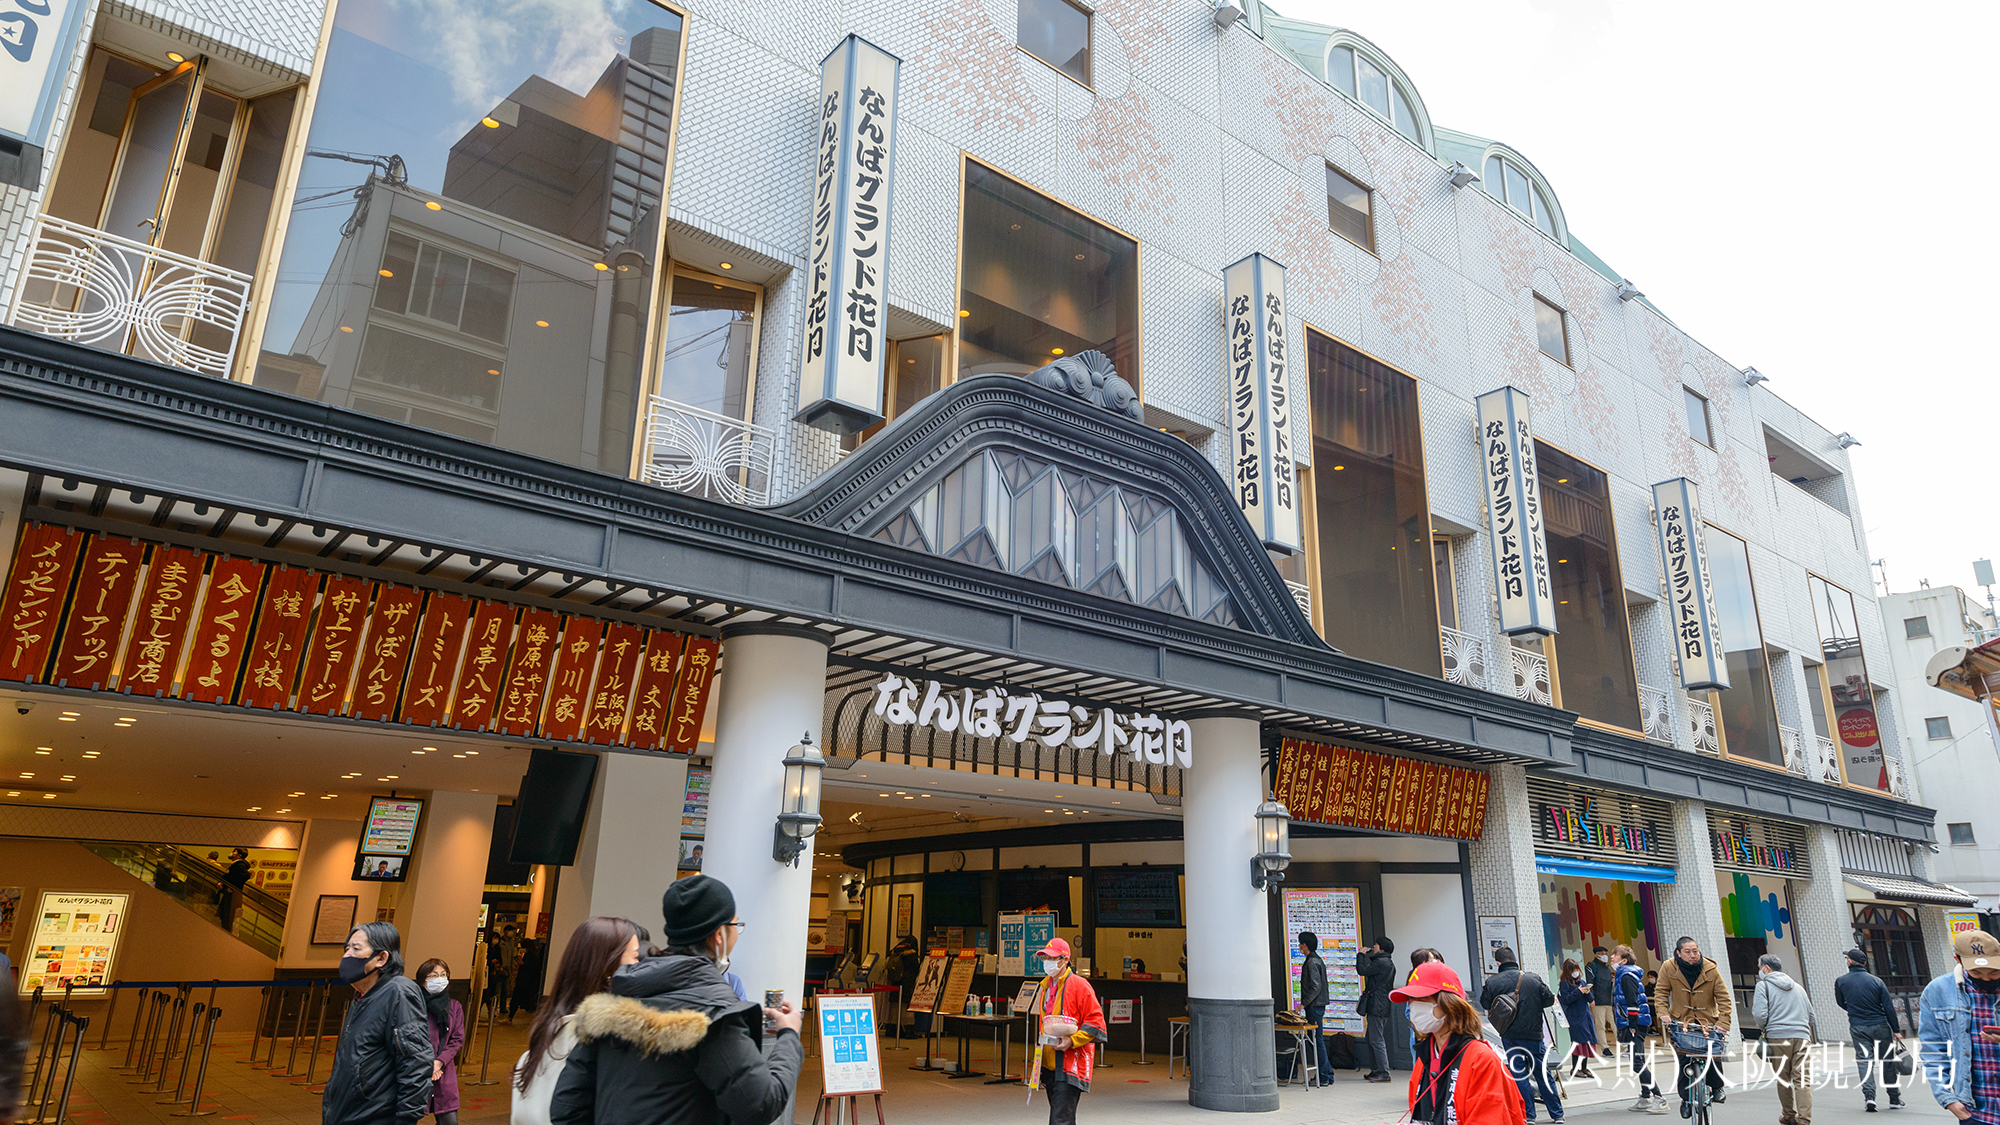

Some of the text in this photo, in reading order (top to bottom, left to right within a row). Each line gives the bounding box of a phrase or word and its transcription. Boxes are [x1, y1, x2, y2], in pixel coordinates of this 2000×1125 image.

[807, 89, 840, 364] なんばグランド花月
[846, 84, 887, 362] なんばグランド花月
[1231, 294, 1260, 511] なんばグランド花月
[1266, 291, 1292, 510] なんばグランド花月
[1486, 420, 1523, 600] なんばグランド花月
[1517, 418, 1548, 600] なんばグランド花月
[11, 540, 64, 670] メッセンジャー
[71, 551, 128, 675] ティーアップ
[128, 560, 190, 686] まるむし商店
[197, 572, 252, 688] 今くるよ
[1662, 506, 1702, 660] なんばグランド花月
[1691, 506, 1723, 661] なんばグランド花月
[310, 589, 362, 703] 村上ショージ
[411, 610, 456, 710] トミーズ
[460, 616, 502, 719] 月亭八方
[553, 635, 592, 724] 中川家
[674, 646, 712, 745] 西川きよし
[871, 671, 1194, 770] なんばグランド花月
[1374, 764, 1391, 822] 坂田利夫
[1390, 766, 1406, 824] ハイヒール
[1421, 772, 1434, 828] テンダラー
[1432, 772, 1449, 831] 吉本新喜劇
[1971, 943, 1985, 955] NY
